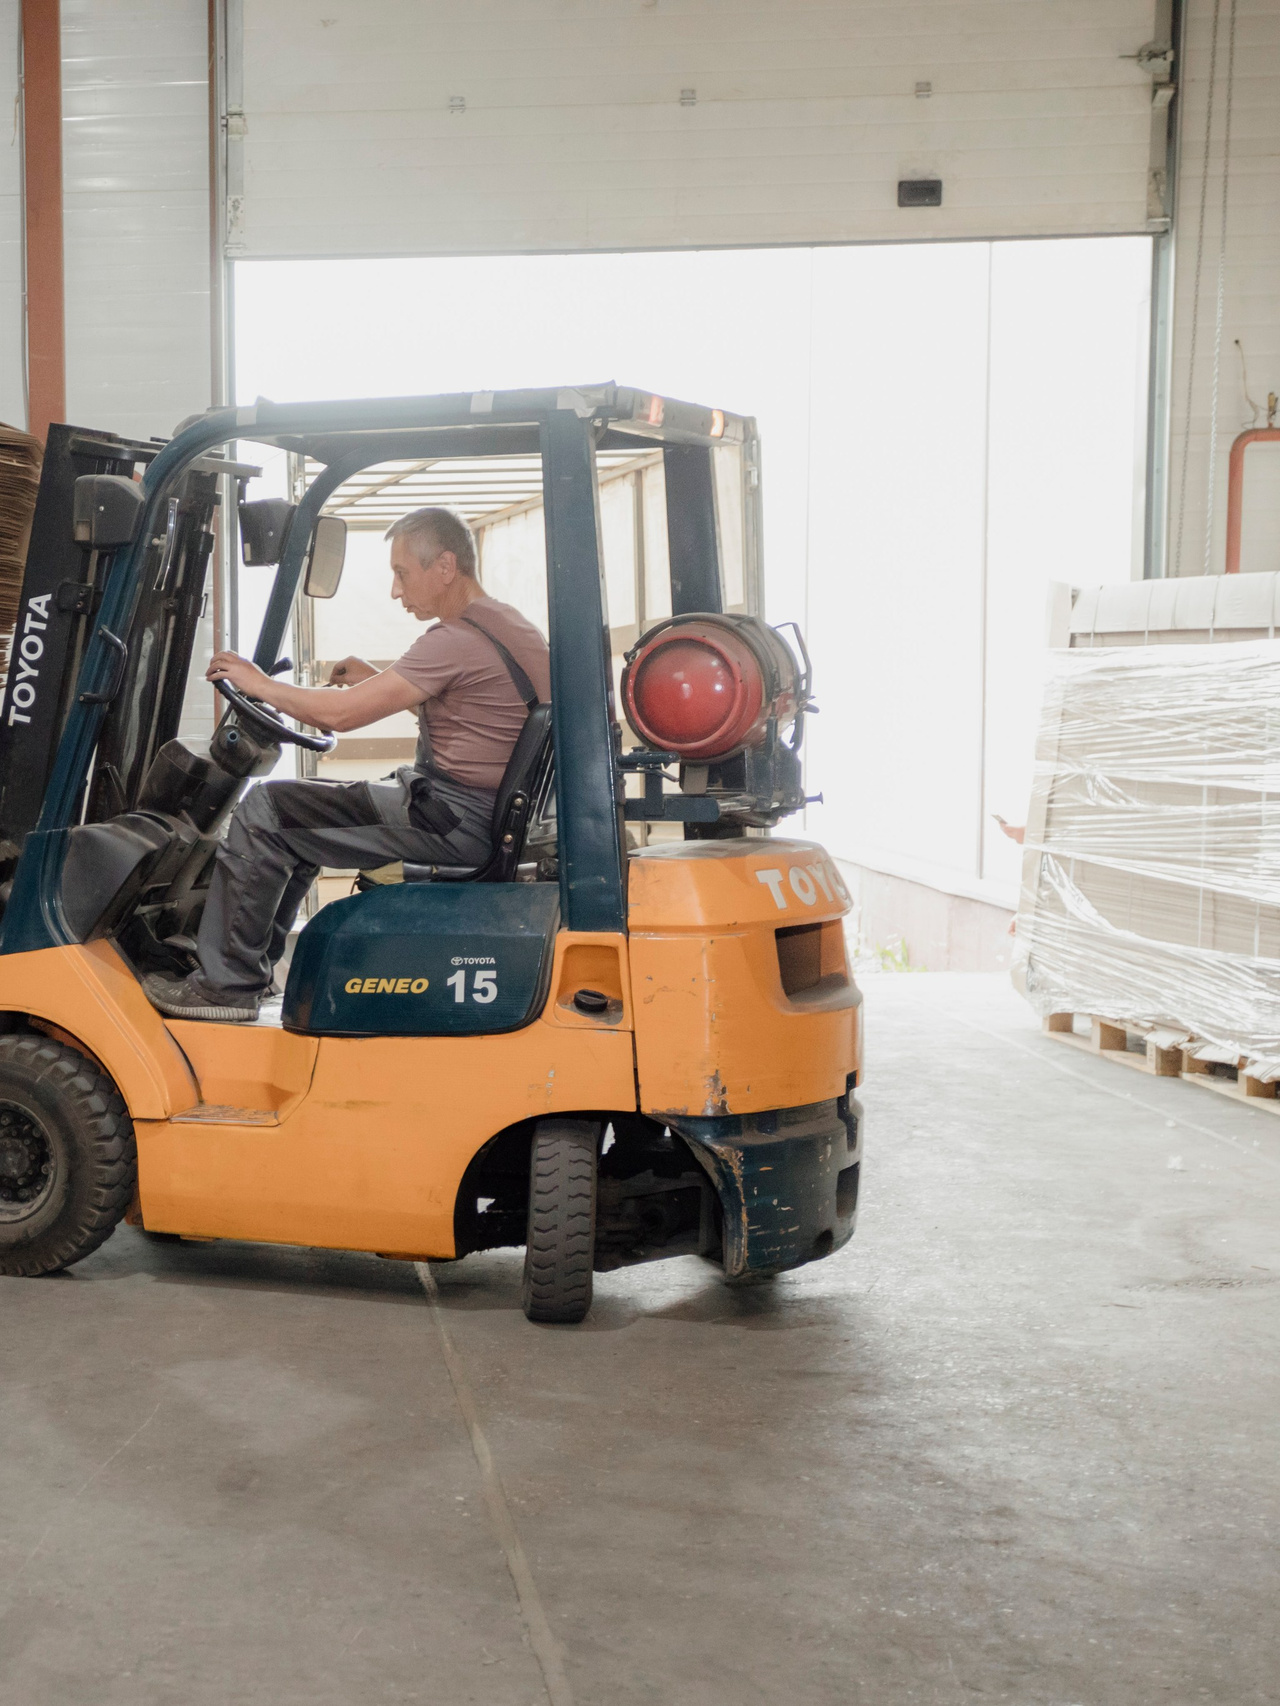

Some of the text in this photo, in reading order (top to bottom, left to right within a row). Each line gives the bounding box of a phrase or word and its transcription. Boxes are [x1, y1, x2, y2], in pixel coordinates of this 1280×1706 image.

[7, 593, 53, 727] TOYOTA
[463, 957, 496, 965] TOYOTA
[344, 977, 430, 994] GENEO
[446, 969, 498, 1004] 15
